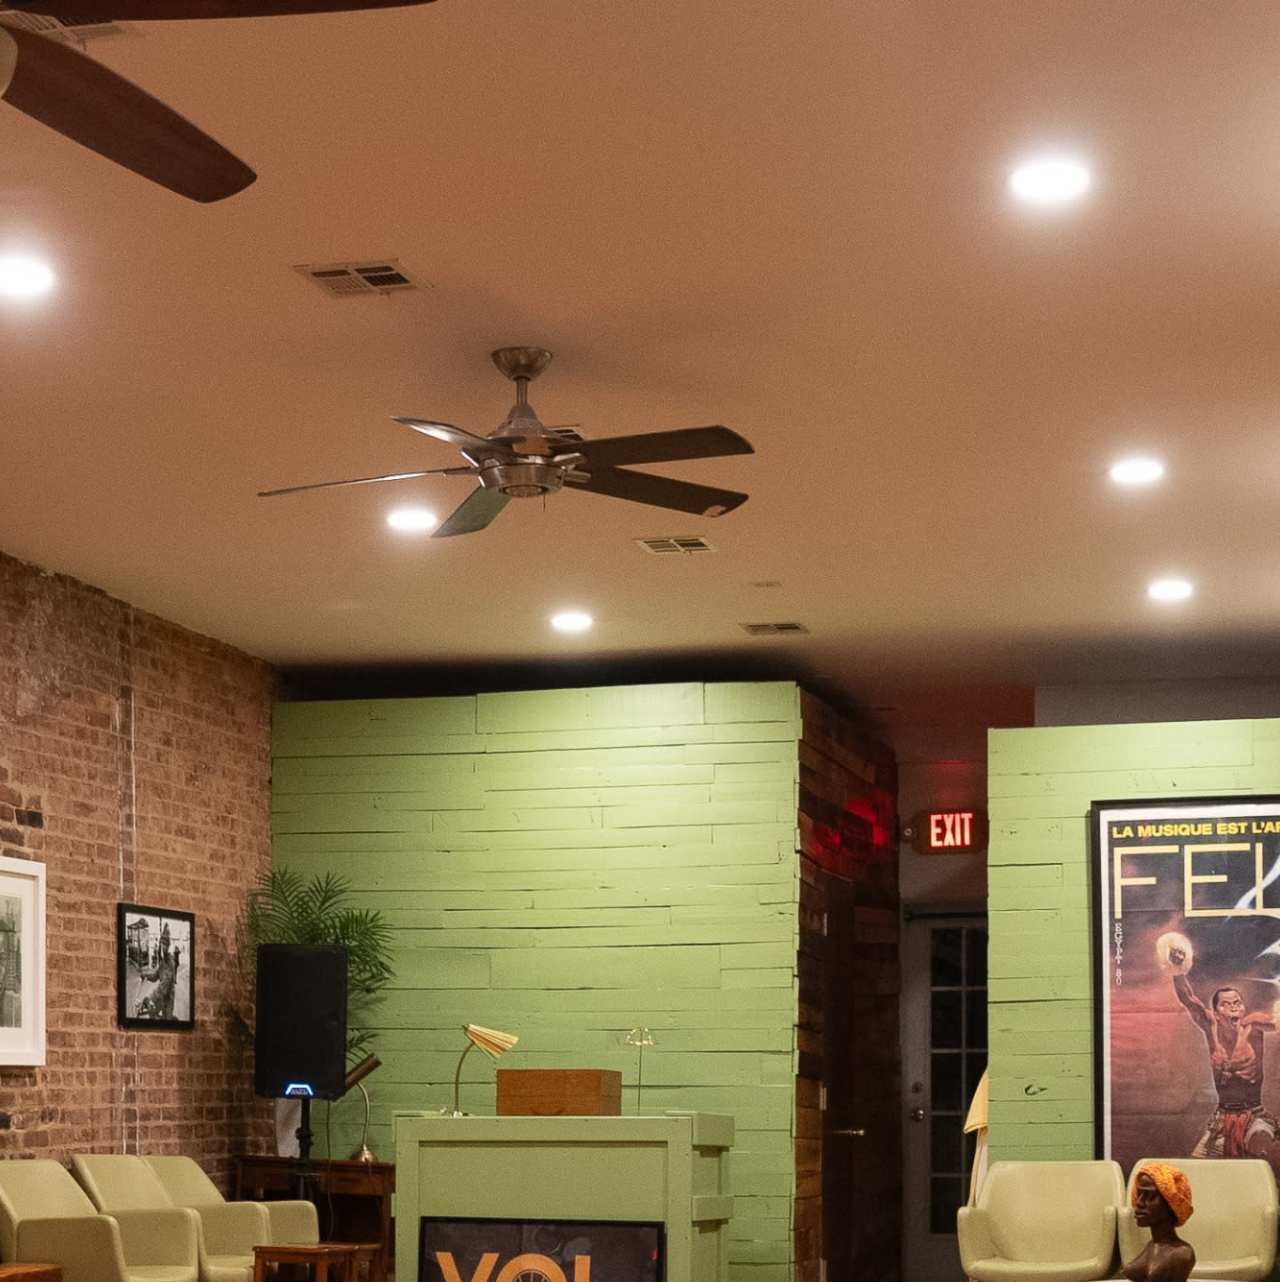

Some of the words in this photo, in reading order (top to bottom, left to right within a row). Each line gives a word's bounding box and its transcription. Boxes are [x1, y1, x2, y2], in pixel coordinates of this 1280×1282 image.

[930, 813, 973, 847] EXIT
[1112, 826, 1134, 838] LA
[1137, 823, 1213, 838] MUSIQUE
[1216, 822, 1248, 835] EST
